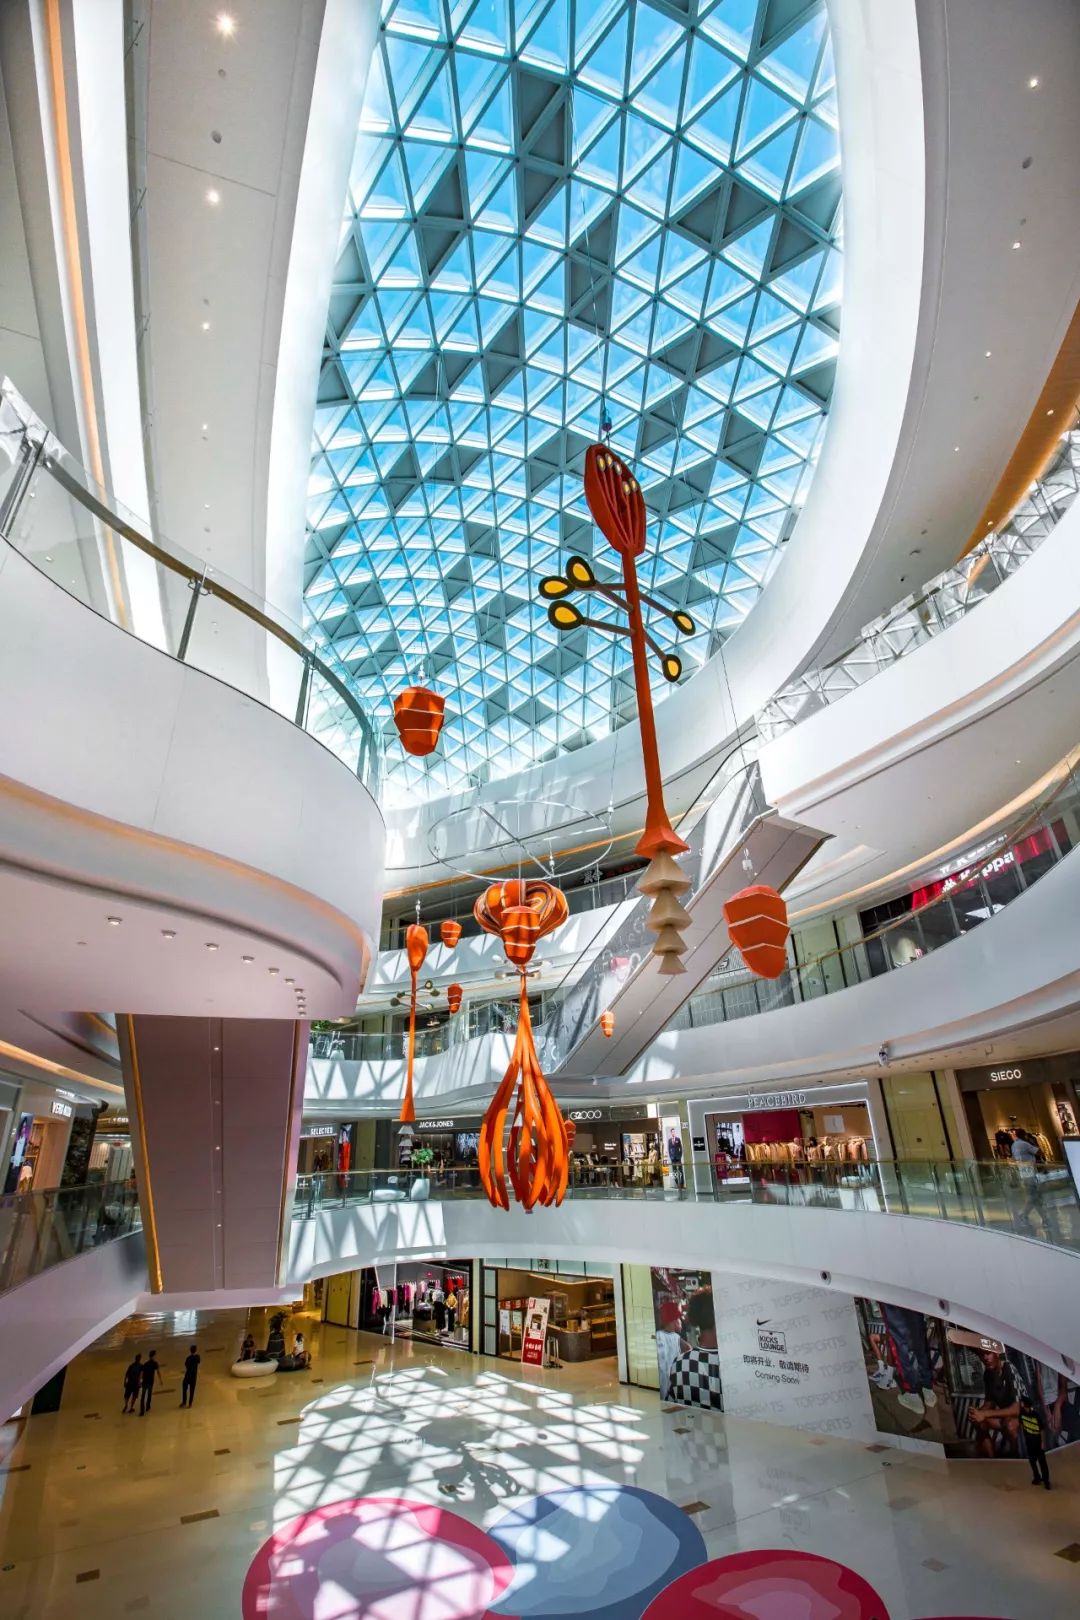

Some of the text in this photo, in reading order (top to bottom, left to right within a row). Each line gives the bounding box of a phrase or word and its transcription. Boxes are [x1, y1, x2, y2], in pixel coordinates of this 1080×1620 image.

[990, 1069, 1022, 1082] SIEGO
[747, 1093, 806, 1109] PEACEBIRD
[569, 1110, 602, 1120] G2000
[759, 1335, 779, 1344] KICKS
[760, 1342, 785, 1352] LOUNGE
[755, 1370, 800, 1384] Coming Soon
